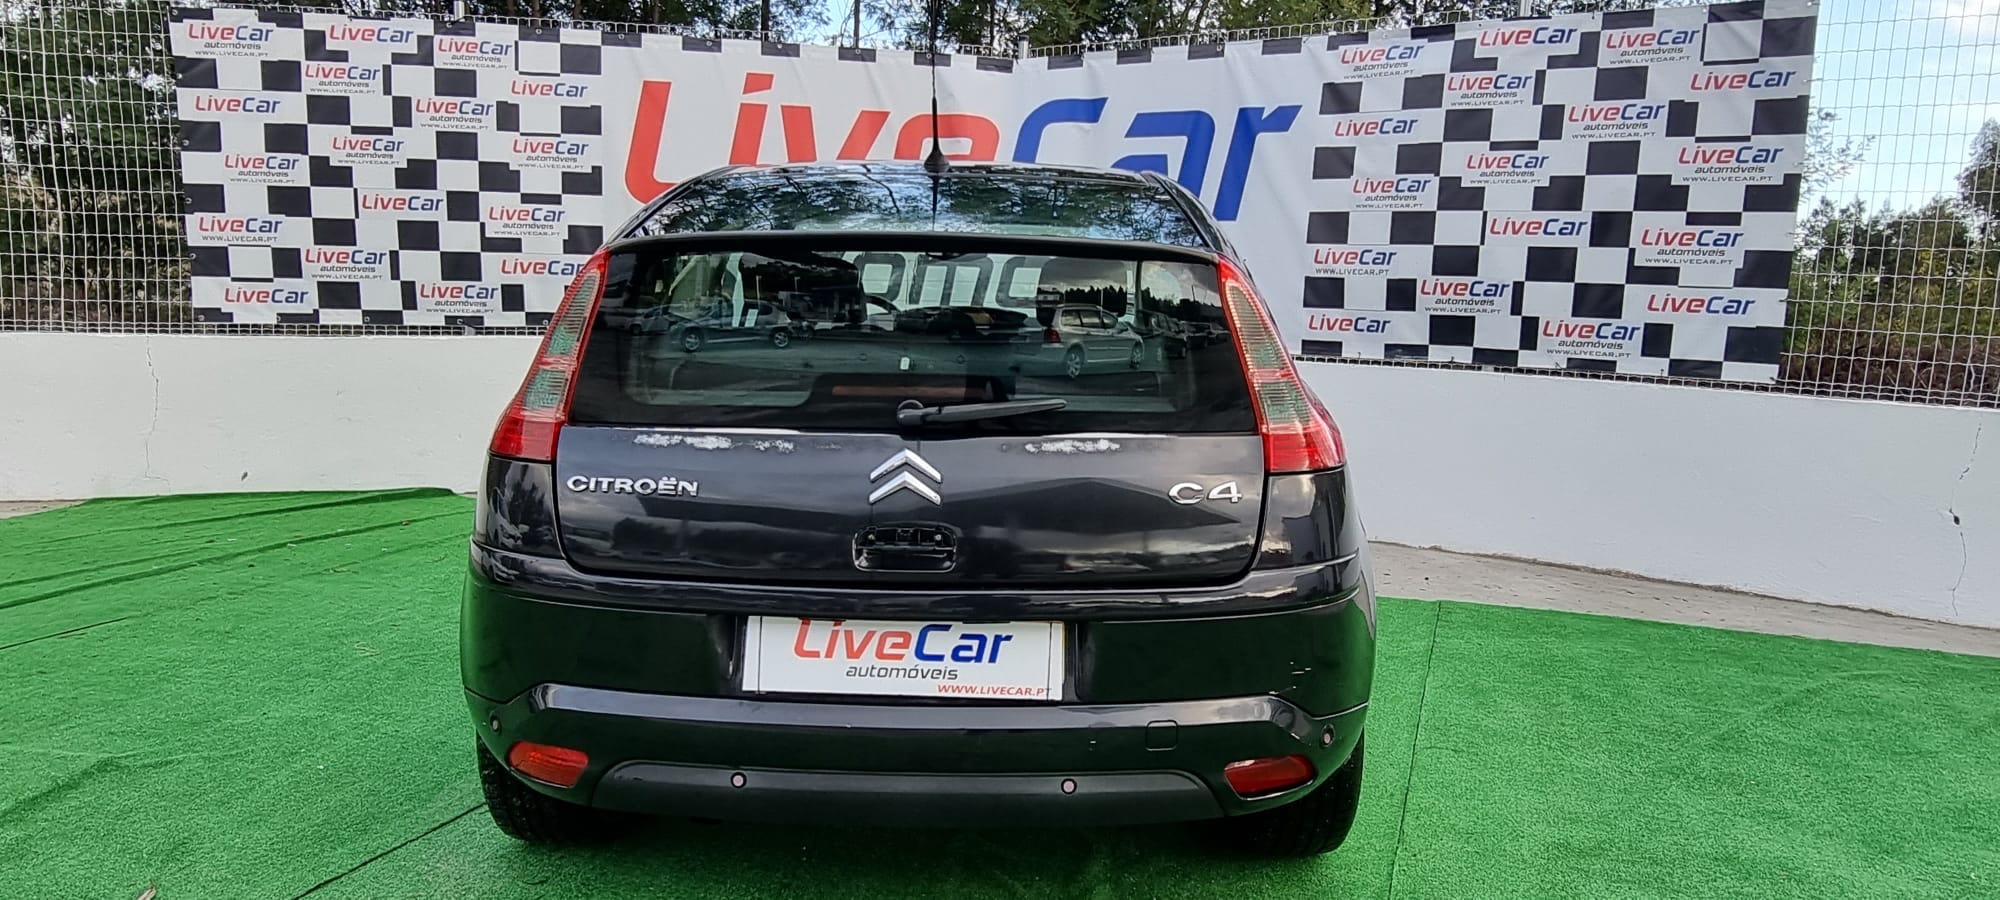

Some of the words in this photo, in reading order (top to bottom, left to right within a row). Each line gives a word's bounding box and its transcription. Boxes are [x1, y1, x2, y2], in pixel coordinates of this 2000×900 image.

[188, 23, 274, 42] LiveCar
[329, 23, 415, 43] LiveCar
[1480, 27, 1577, 47] LiveCar
[1606, 28, 1700, 49] LiveCar
[204, 42, 261, 50] automóveis
[438, 37, 513, 56] LiveCar
[1341, 45, 1425, 64] LiveCar
[1620, 47, 1684, 57] automóveis
[451, 54, 502, 63] automóveis
[1353, 61, 1409, 72] automóveis
[1609, 56, 1690, 65] WWW.LIVECAR.PT
[305, 64, 380, 81] LiveCar
[1344, 69, 1415, 80] WWW.LIVECAR.PT
[1690, 70, 1797, 91] LiveCar
[319, 80, 369, 88] automóveis
[511, 80, 588, 98] LiveCar
[1448, 74, 1533, 91] LiveCar
[1460, 90, 1518, 99] automóveis
[195, 95, 281, 114] LiveCar
[415, 97, 494, 116] LiveCar
[1568, 103, 1666, 122] LiveCar
[429, 115, 482, 124] automóveis
[1335, 118, 1418, 136] LiveCar
[1583, 121, 1648, 131] automóveis
[332, 136, 404, 152] LiveCar
[1571, 132, 1656, 140] WWW.LIVECAR.PT
[513, 138, 589, 156] LiveCar
[1678, 145, 1784, 165] LiveCar
[224, 153, 300, 171] LiveCar
[526, 155, 577, 163] automóveis
[1467, 153, 1550, 169] LiveCar
[238, 170, 289, 178] automóveis
[1480, 170, 1535, 178] automóveis
[1695, 164, 1765, 173] automóveis
[1352, 177, 1431, 194] LiveCar
[362, 194, 444, 211] LiveCar
[1365, 194, 1418, 202] automóveis
[489, 205, 566, 223] LiveCar
[199, 216, 283, 234] LiveCar
[502, 222, 554, 230] automóveis
[1490, 217, 1588, 236] LiveCar
[201, 235, 278, 243] WWW.LIVECAR.PT
[1641, 227, 1744, 247] LiveCar
[305, 247, 388, 265] LiveCar
[1314, 248, 1397, 266] LiveCar
[1657, 248, 1726, 257] automóveis
[319, 265, 376, 273] automóveis
[1315, 268, 1390, 276] WWW.LIVECAR.PT
[224, 287, 309, 304] LiveCar
[420, 283, 499, 300] LiveCar
[1420, 279, 1510, 297] LiveCar
[1425, 306, 1502, 315] WWW.LIVECAR.PT
[1434, 297, 1495, 307] automóveis
[1647, 293, 1755, 316] LiveCar
[1308, 314, 1391, 333] LiveCar
[1542, 320, 1641, 341] LiveCar
[1547, 349, 1631, 358] WWW.LIVECAR.PT
[1558, 340, 1623, 350] automóveis
[566, 475, 699, 497] CITROËN
[1168, 481, 1242, 504] C4
[793, 619, 1014, 663] LiveCar
[846, 664, 959, 681] automóveis
[937, 684, 1052, 697] WWW.LIVECAR.PT
